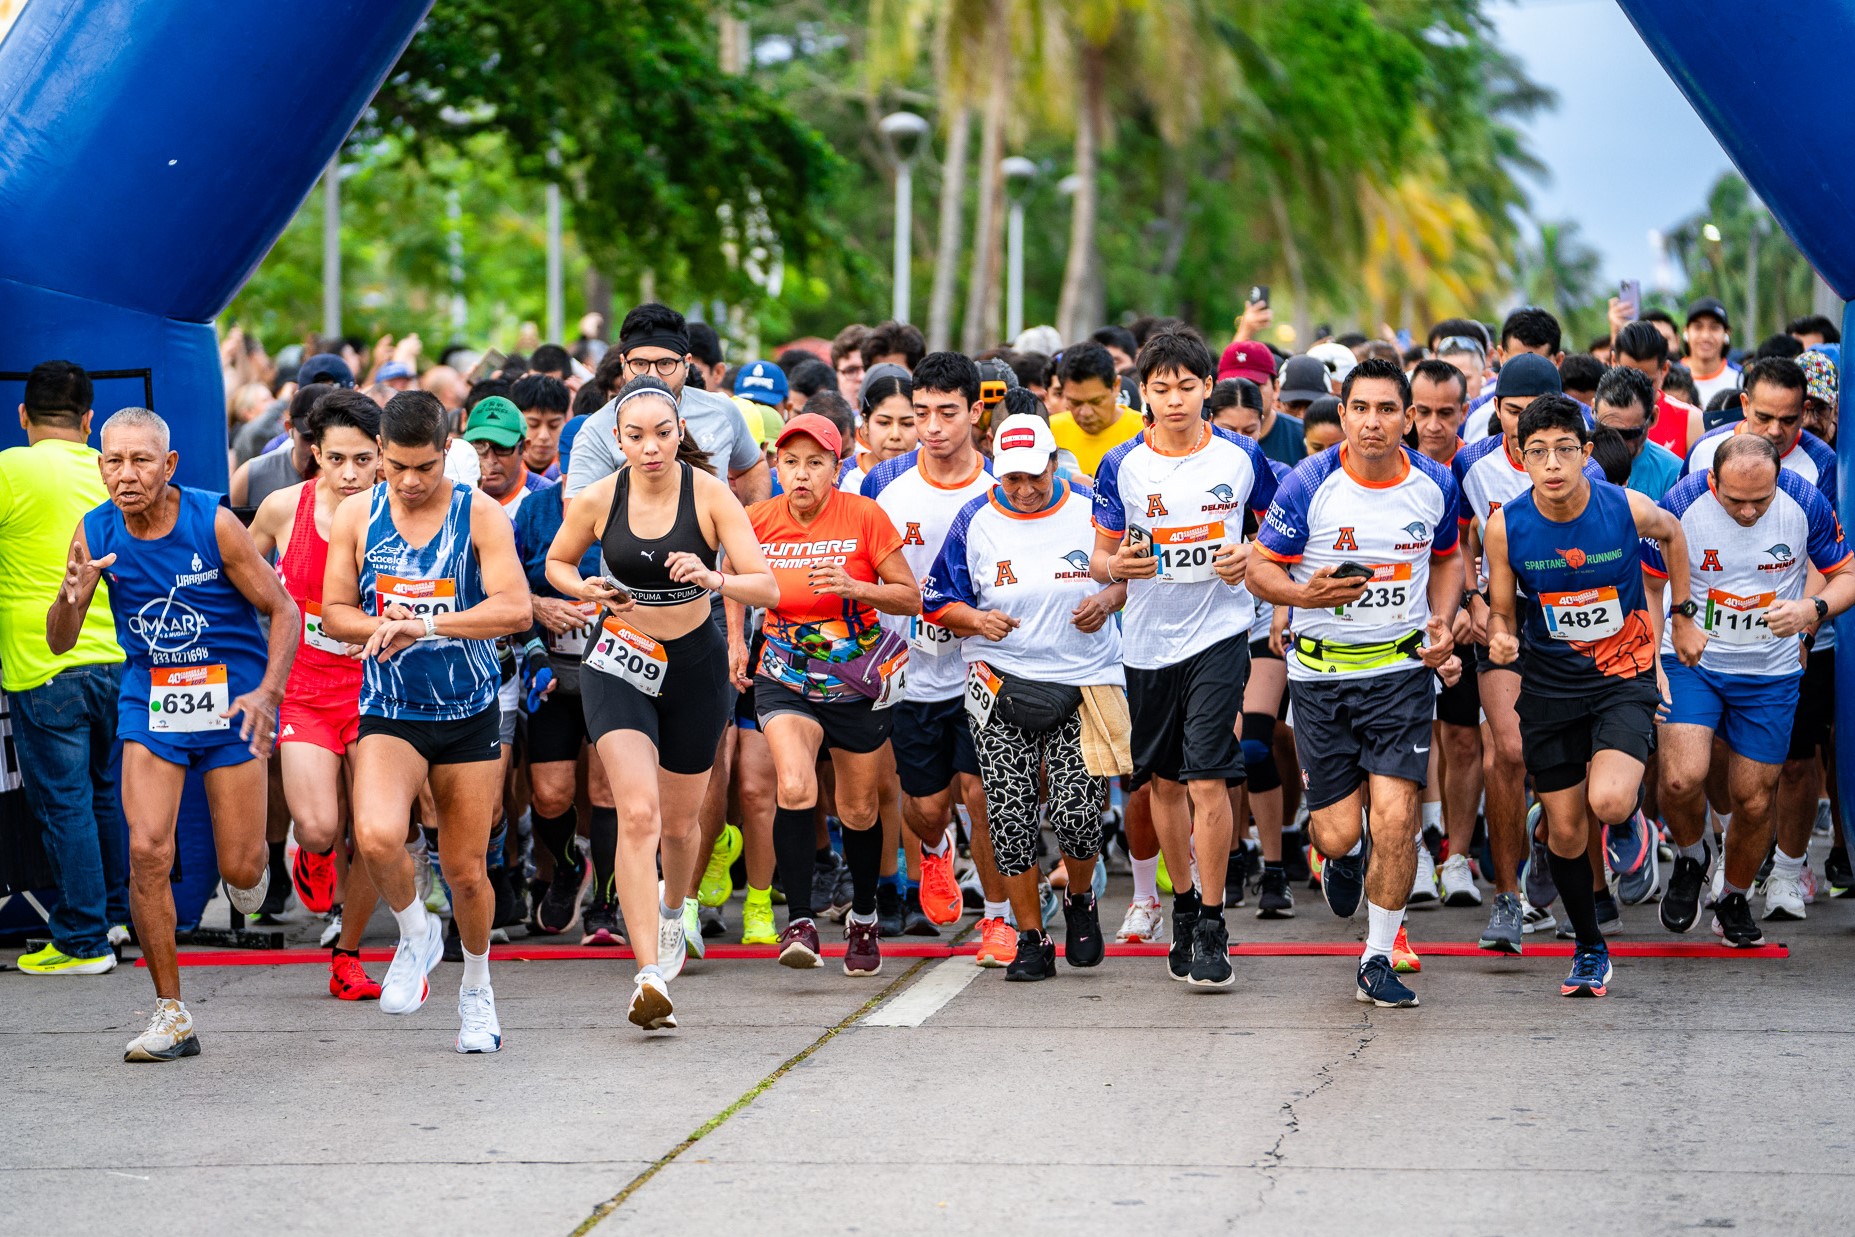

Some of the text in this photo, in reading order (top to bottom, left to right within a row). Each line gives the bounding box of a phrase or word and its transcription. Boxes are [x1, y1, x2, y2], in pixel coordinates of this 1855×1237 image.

[1146, 494, 1168, 517] A
[904, 522, 925, 545] A
[1169, 531, 1184, 543] 40
[1333, 527, 1358, 550] A
[760, 539, 857, 556] RUNNERS
[1161, 543, 1222, 568] 1207
[1525, 549, 1623, 570] SPARTANS RUNNING
[1700, 549, 1723, 571] A
[176, 568, 219, 588] WARRIORS
[995, 560, 1018, 587] A
[393, 583, 407, 594] 40
[638, 592, 661, 600] PUMA
[677, 588, 698, 599] PUMA
[1346, 586, 1406, 608] 235
[384, 600, 450, 616] 80
[1558, 607, 1610, 628] 482
[1714, 609, 1769, 630] 1114
[916, 619, 963, 643] 103
[153, 646, 209, 664] 833 4271698
[605, 638, 660, 681] 1209
[167, 672, 181, 684] 40
[163, 691, 215, 714] 634
